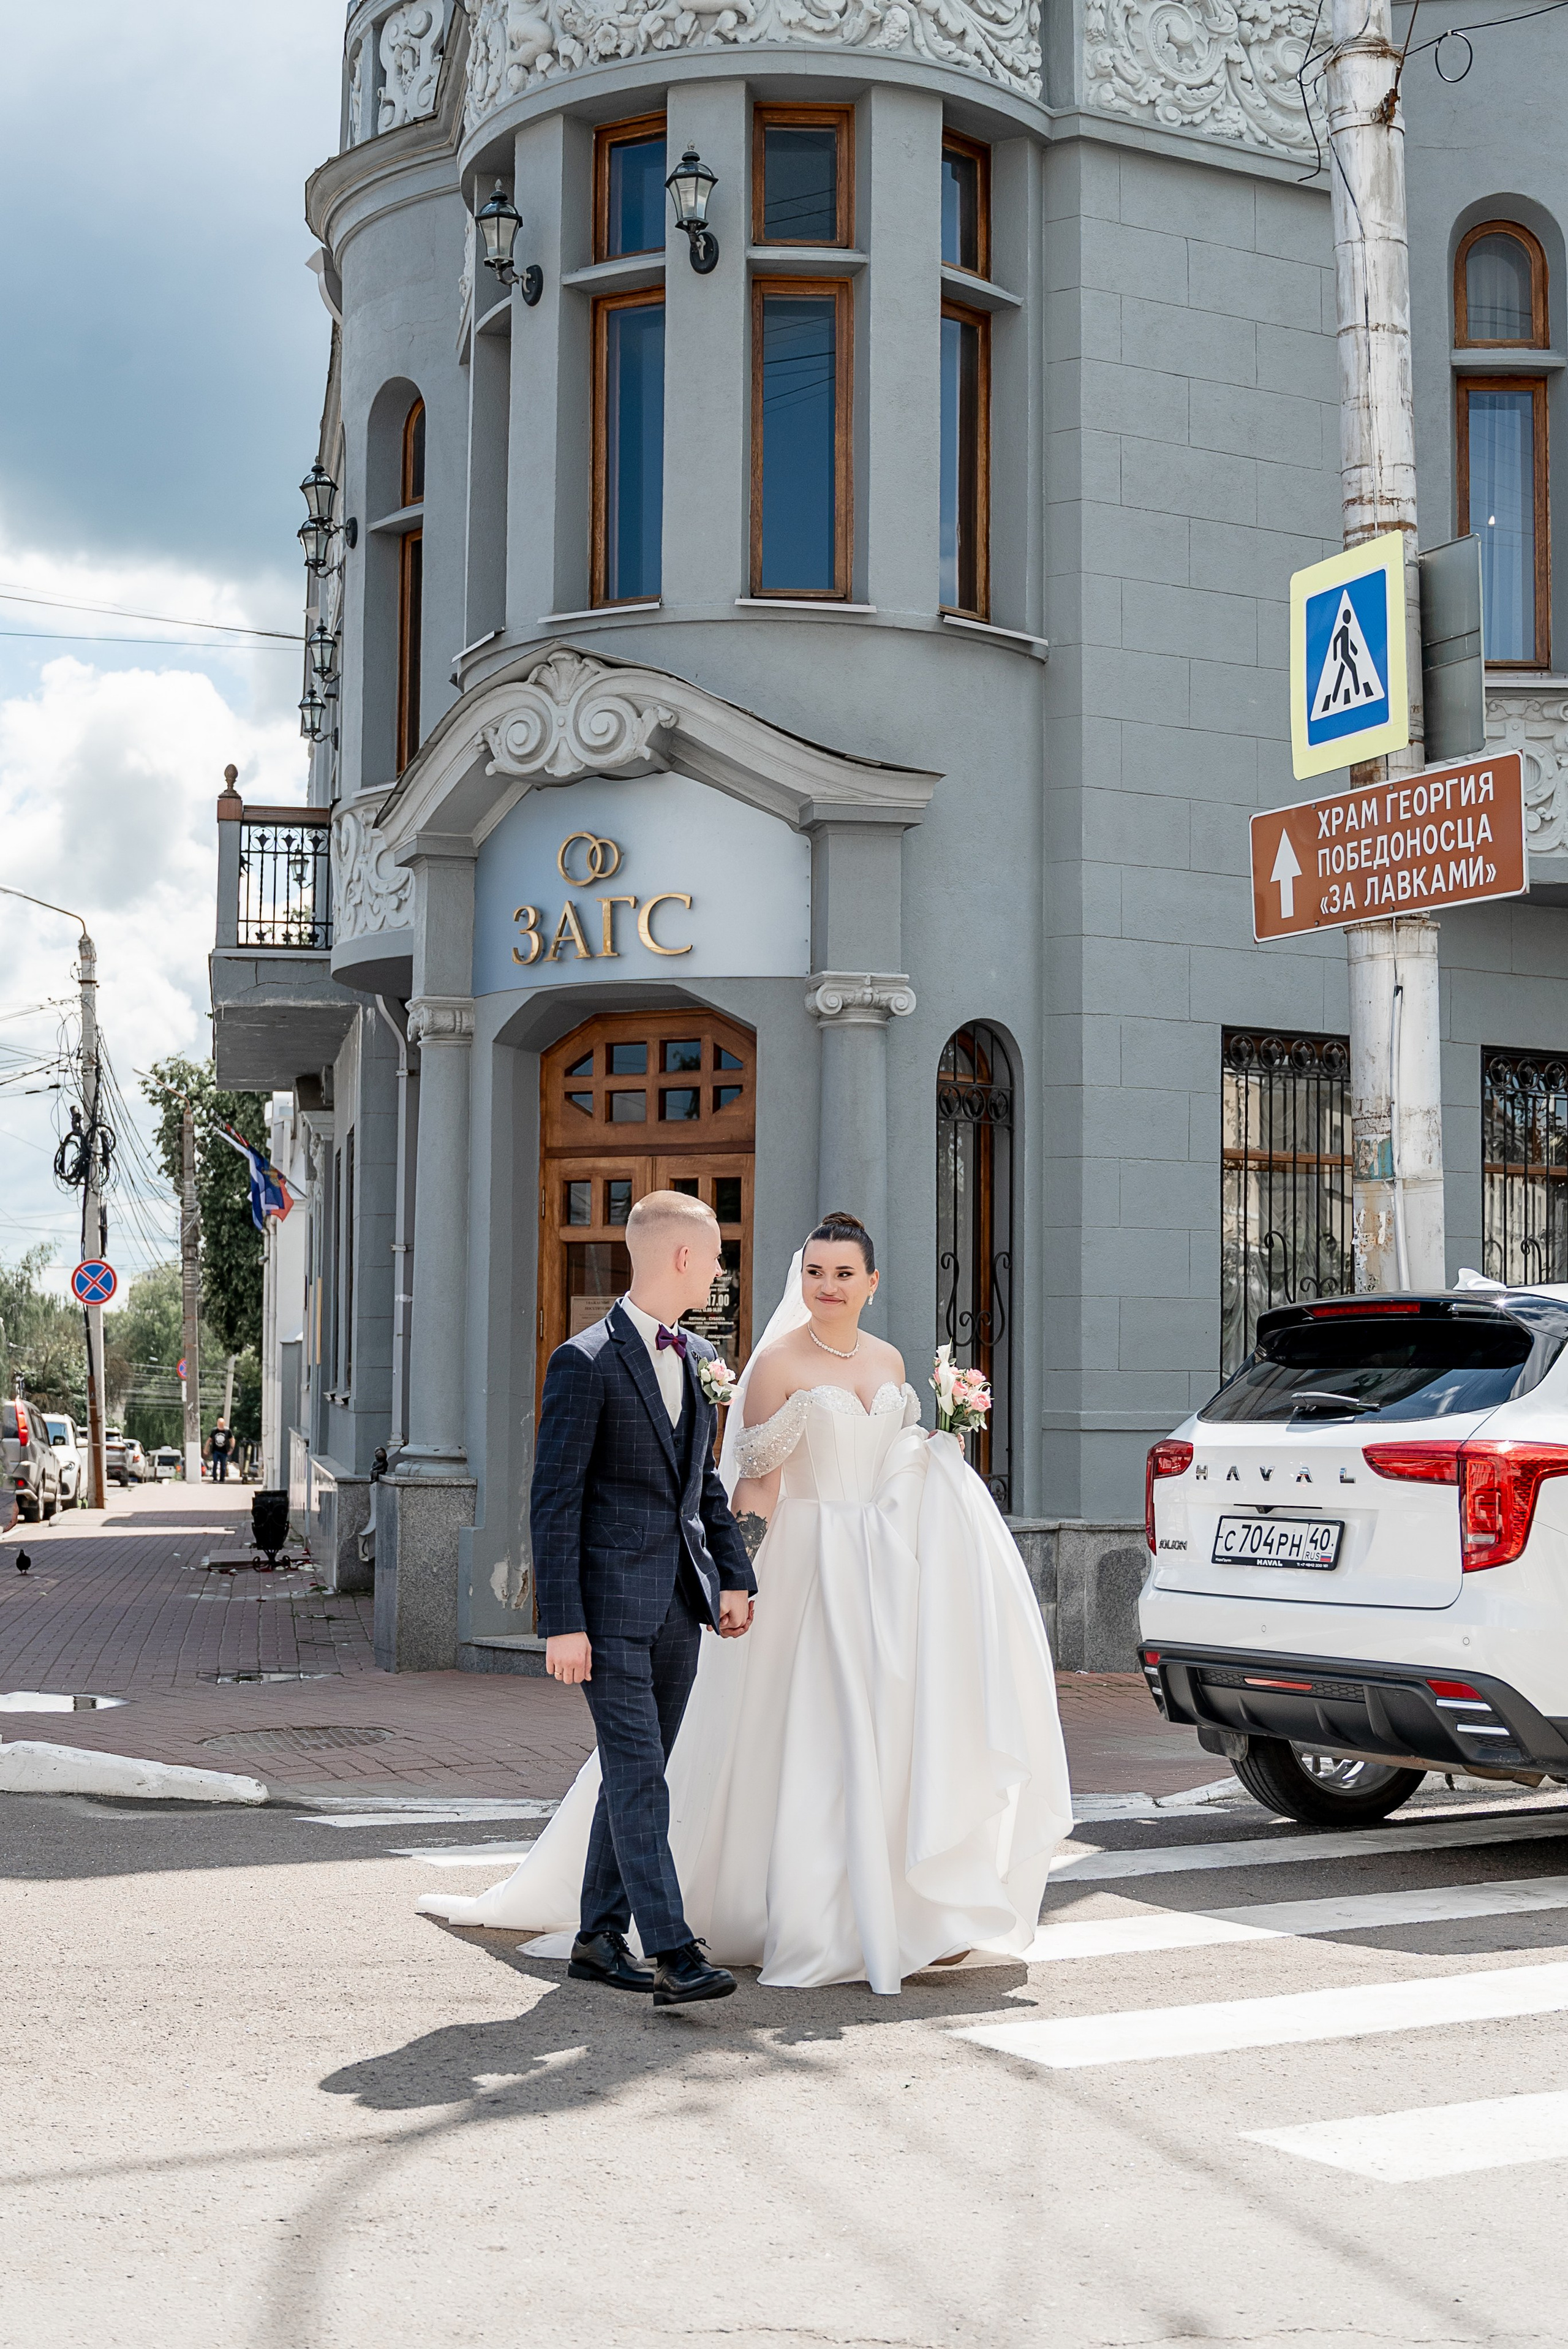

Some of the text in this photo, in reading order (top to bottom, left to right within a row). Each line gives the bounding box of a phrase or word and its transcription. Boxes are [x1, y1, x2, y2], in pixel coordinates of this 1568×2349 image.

[1317, 771, 1494, 839] ХРАМ ГЕОРГИЯ
[1317, 813, 1493, 877] ПОБЕДОНОСЦА
[1320, 855, 1496, 915] «ЗА ЛАВКАМИ»
[511, 893, 693, 966] ЗАГС
[1196, 1465, 1357, 1483] HAVAL
[1225, 1524, 1331, 1557] С704РН 40
[1305, 1551, 1321, 1560] RUS
